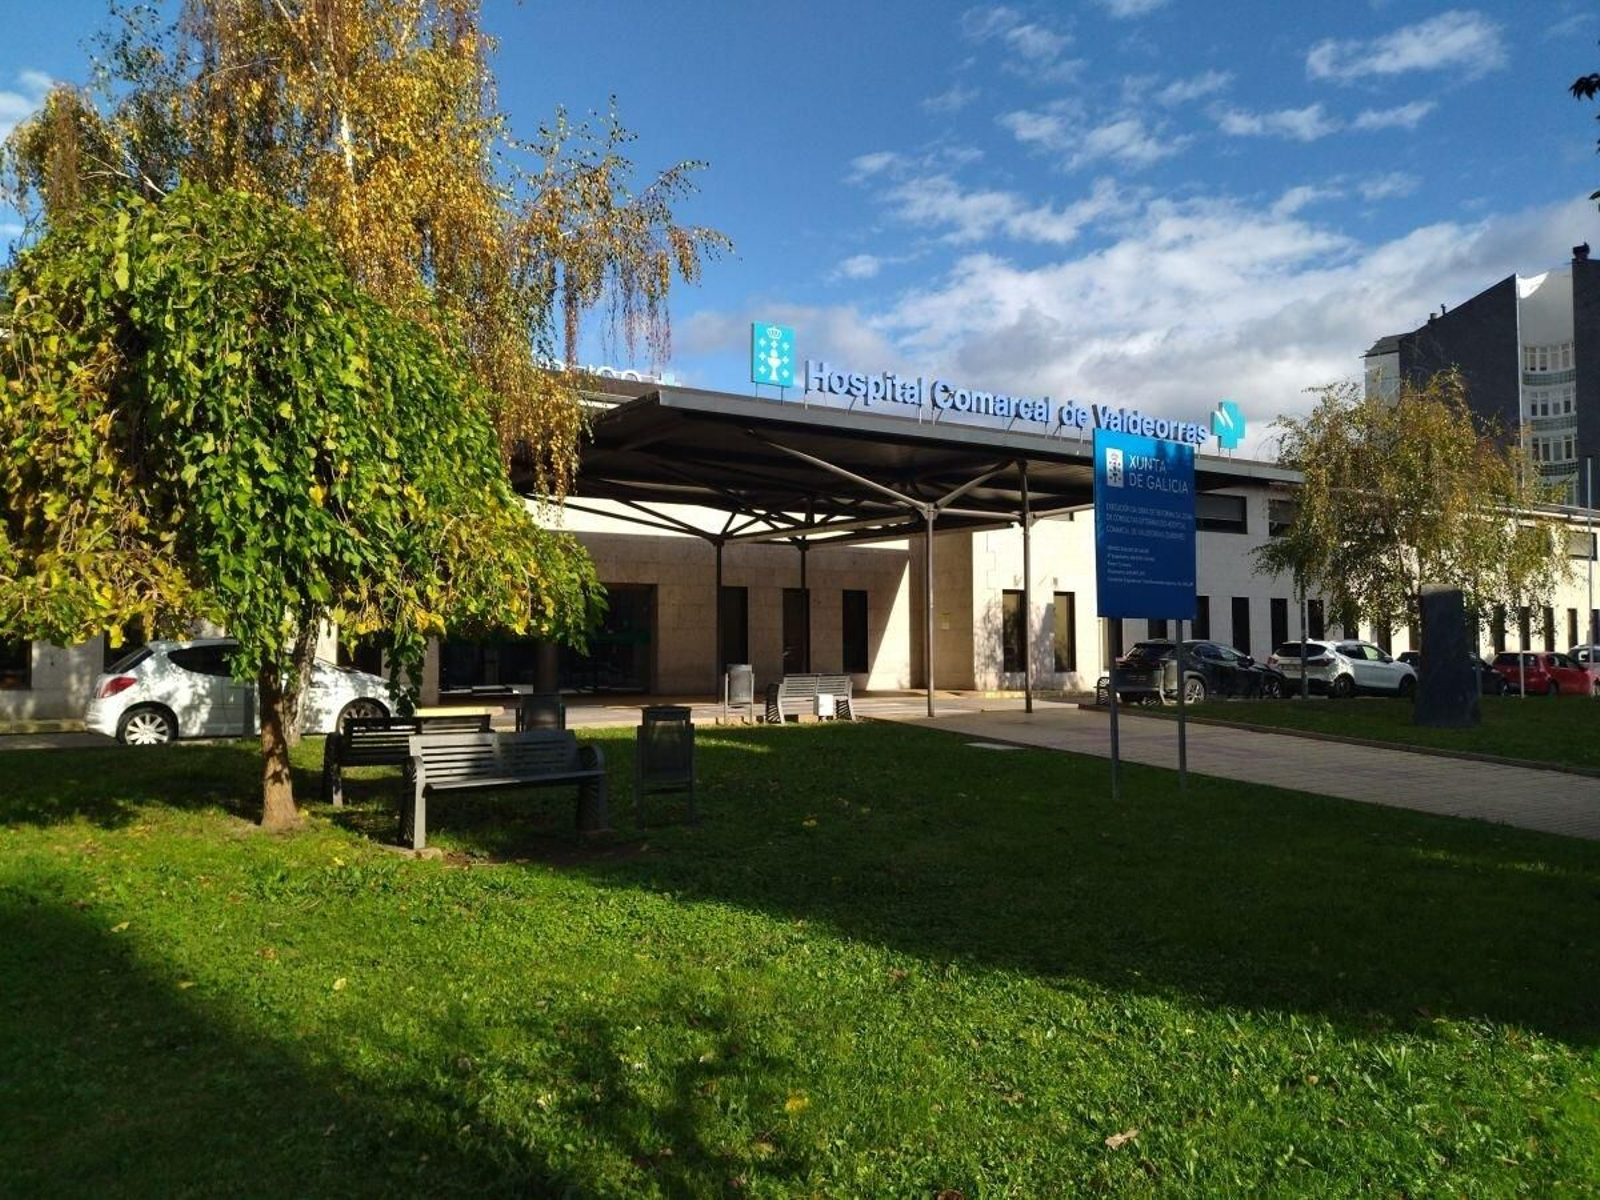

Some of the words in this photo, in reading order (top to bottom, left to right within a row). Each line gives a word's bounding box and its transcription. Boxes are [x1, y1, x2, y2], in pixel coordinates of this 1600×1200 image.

[805, 360, 924, 406] Hospital
[931, 379, 1051, 424] Comarcal
[1059, 401, 1089, 428] de
[1092, 404, 1210, 444] Valdeorras
[1129, 454, 1167, 473] XUNTA
[1129, 472, 1143, 488] DE
[1147, 475, 1189, 494] GALICIA
